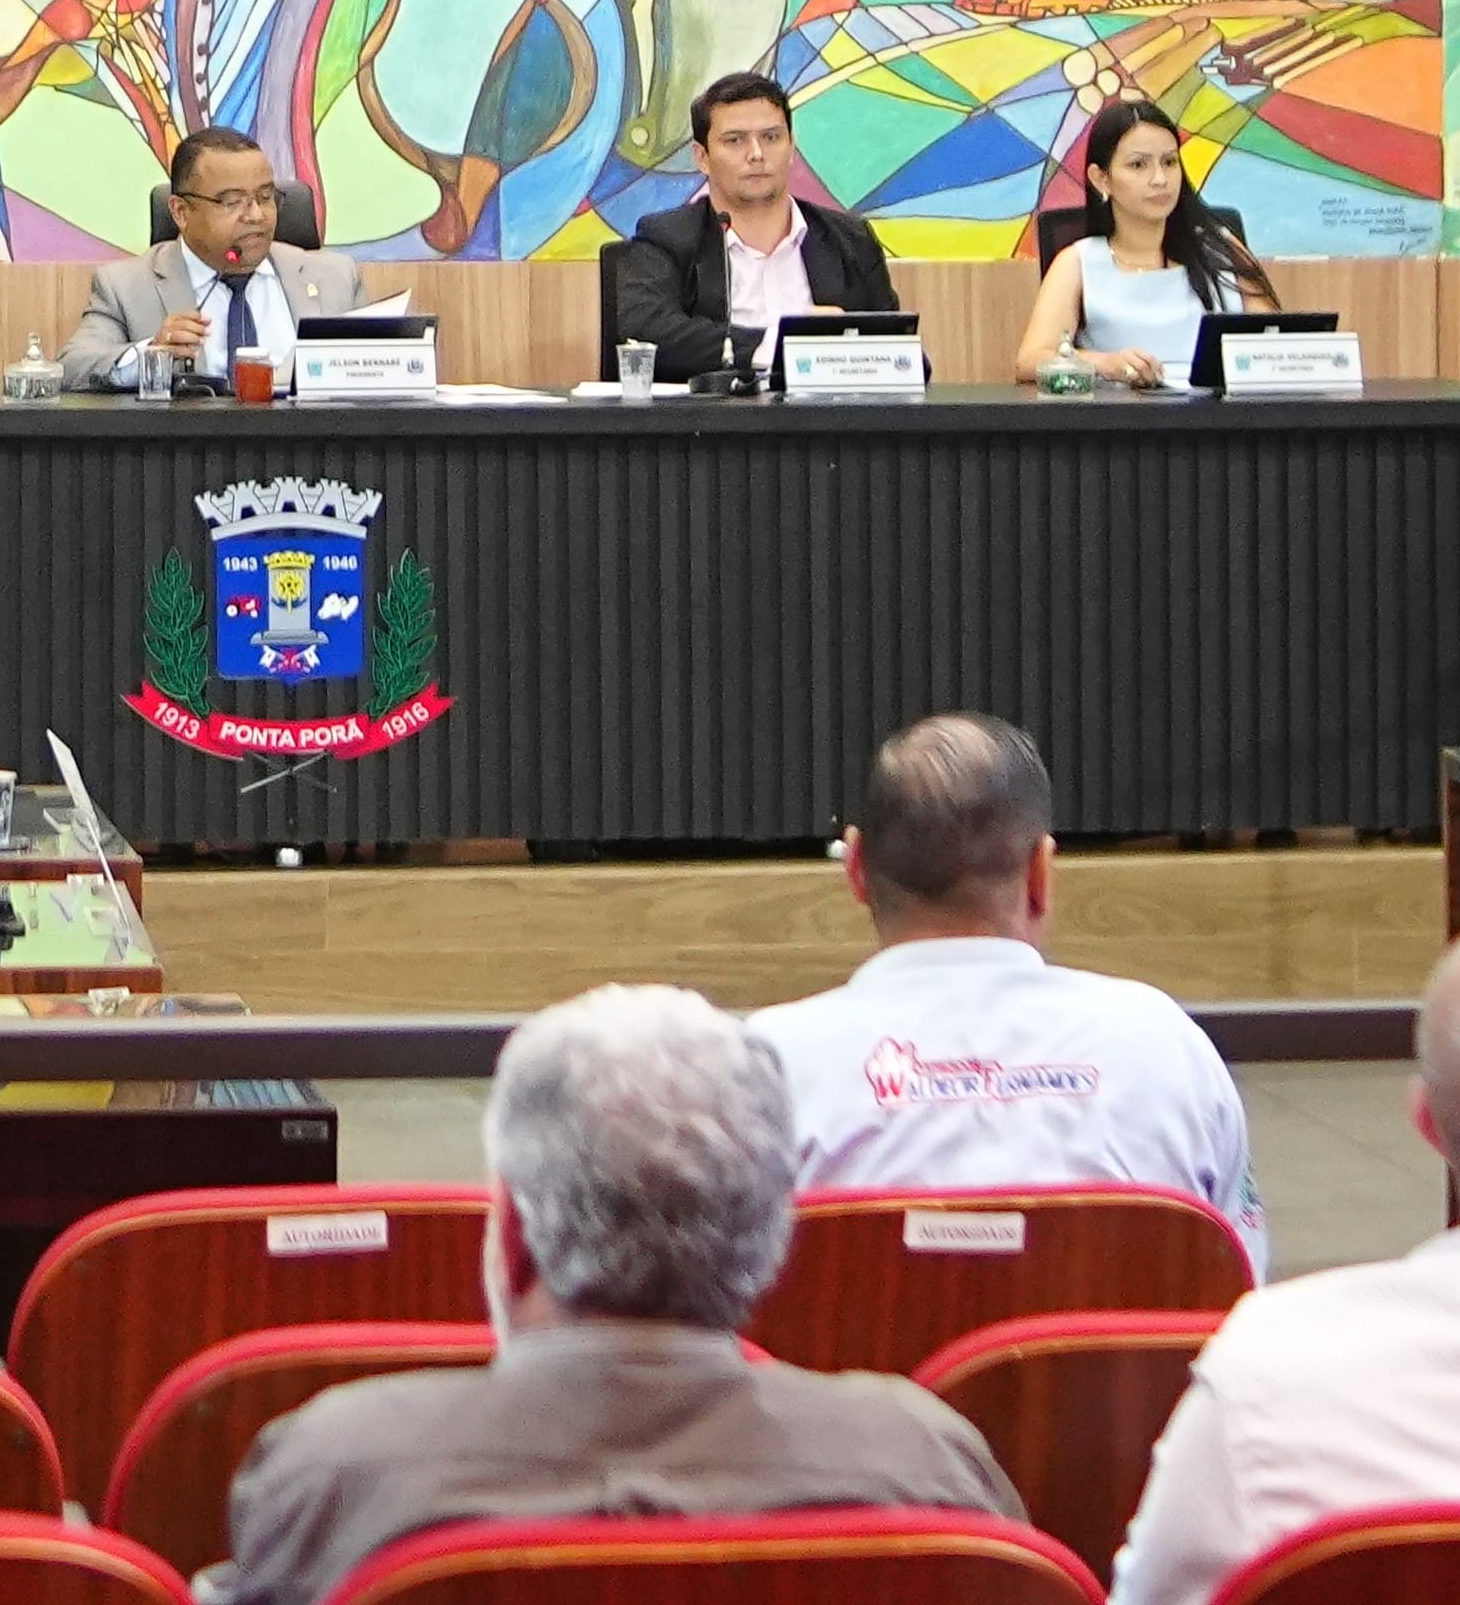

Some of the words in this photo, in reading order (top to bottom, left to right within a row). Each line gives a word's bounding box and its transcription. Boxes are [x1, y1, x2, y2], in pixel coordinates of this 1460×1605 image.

[223, 556, 258, 571] 1943
[154, 701, 201, 739] 1913
[220, 721, 296, 747] PONTA
[300, 718, 364, 746] PORÃ
[381, 701, 429, 739] 1916
[284, 1225, 380, 1244] AUTORIDADE
